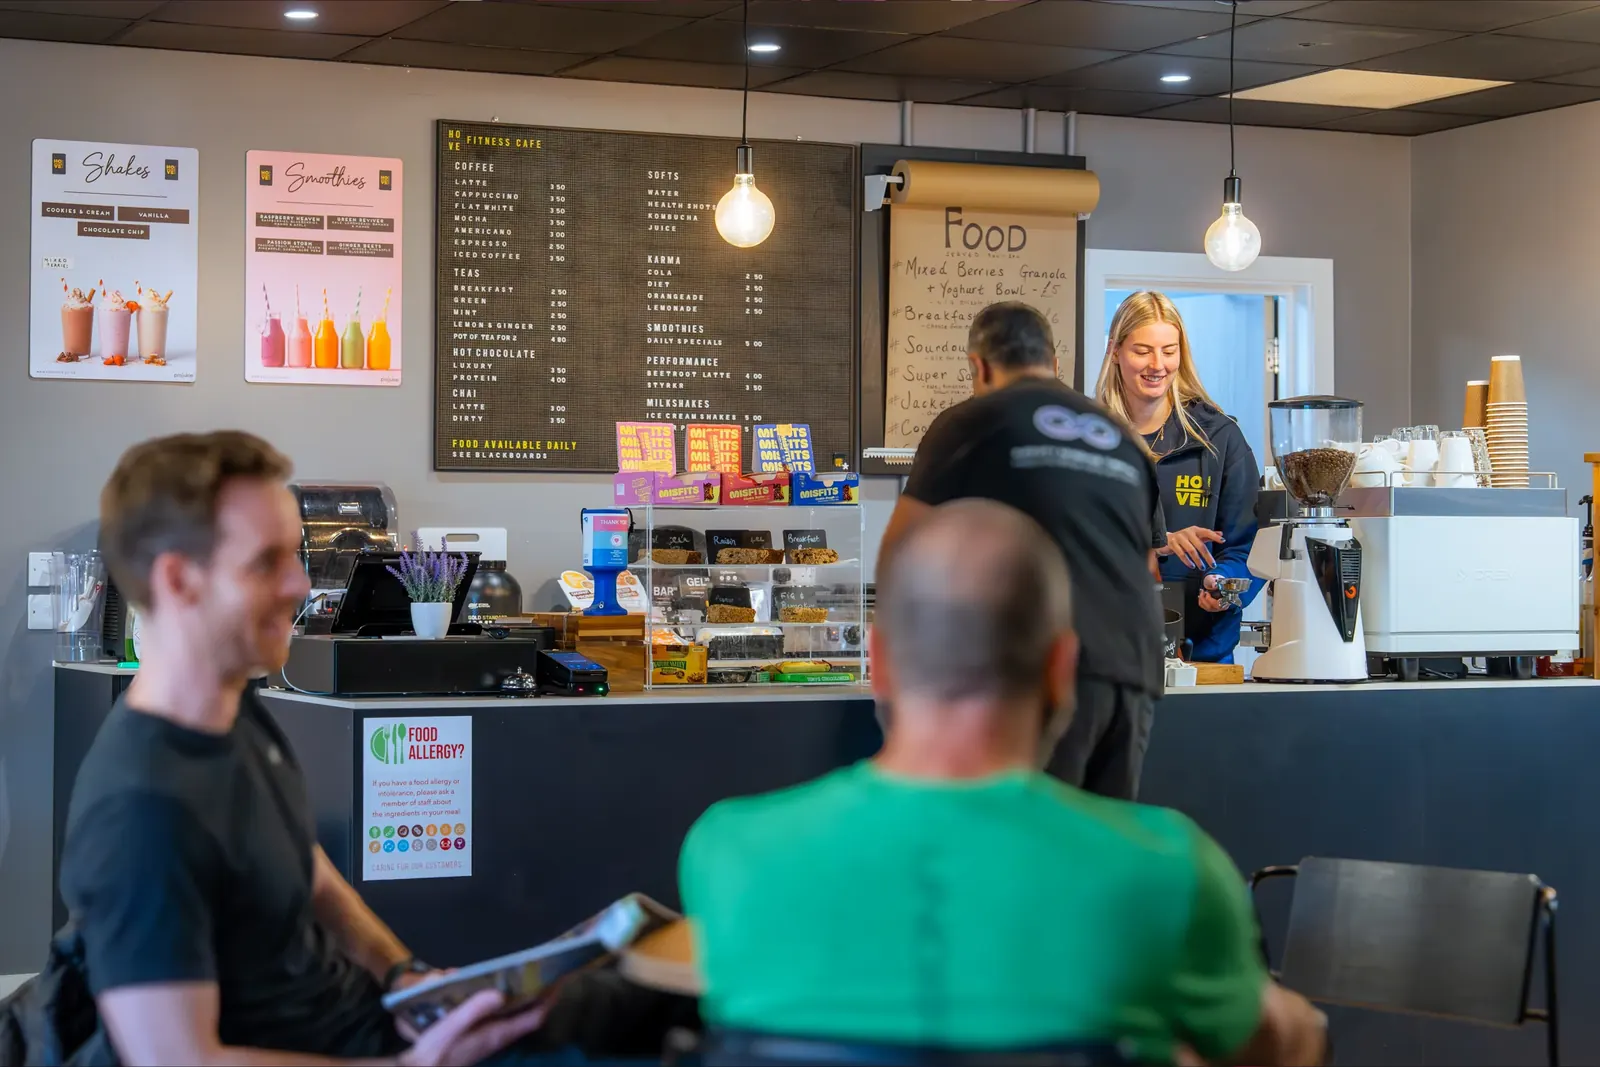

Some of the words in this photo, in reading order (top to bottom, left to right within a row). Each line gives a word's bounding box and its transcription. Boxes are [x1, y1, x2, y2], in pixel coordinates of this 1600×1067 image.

[467, 136, 510, 146] FITNESS
[516, 139, 541, 148] CAFE
[82, 152, 150, 183] Shakes
[455, 162, 494, 172] COFFEE
[285, 162, 366, 192] Smoothies
[648, 171, 679, 180] SOFTS
[455, 191, 518, 200] CAPPUCCINO
[648, 255, 680, 264] KARMA
[454, 269, 480, 277] TEAS
[905, 257, 947, 280] Mixed
[957, 261, 1004, 277] Berries
[1019, 264, 1067, 282] Granola
[940, 281, 984, 299] Yoghurt
[647, 324, 704, 333] SMOOTHIES
[904, 335, 967, 354] Sourdou
[453, 348, 472, 356] HOT
[476, 349, 535, 358] CHOCOLATE
[647, 356, 718, 366] PERFORMANCE
[903, 365, 947, 382] Super
[453, 389, 476, 397] CHAI
[646, 399, 710, 408] MILKSHAKES
[452, 440, 478, 448] FOOD
[484, 440, 541, 449] AVAILABLE
[547, 442, 576, 450] DAILY
[659, 486, 699, 498] MISFITS
[729, 487, 769, 499] MISFITS
[800, 487, 838, 498] MISFITS
[713, 535, 736, 545] Raisin
[788, 534, 819, 543] Breakfast
[408, 727, 438, 742] FOOD
[408, 744, 464, 760] ALLERGY?
